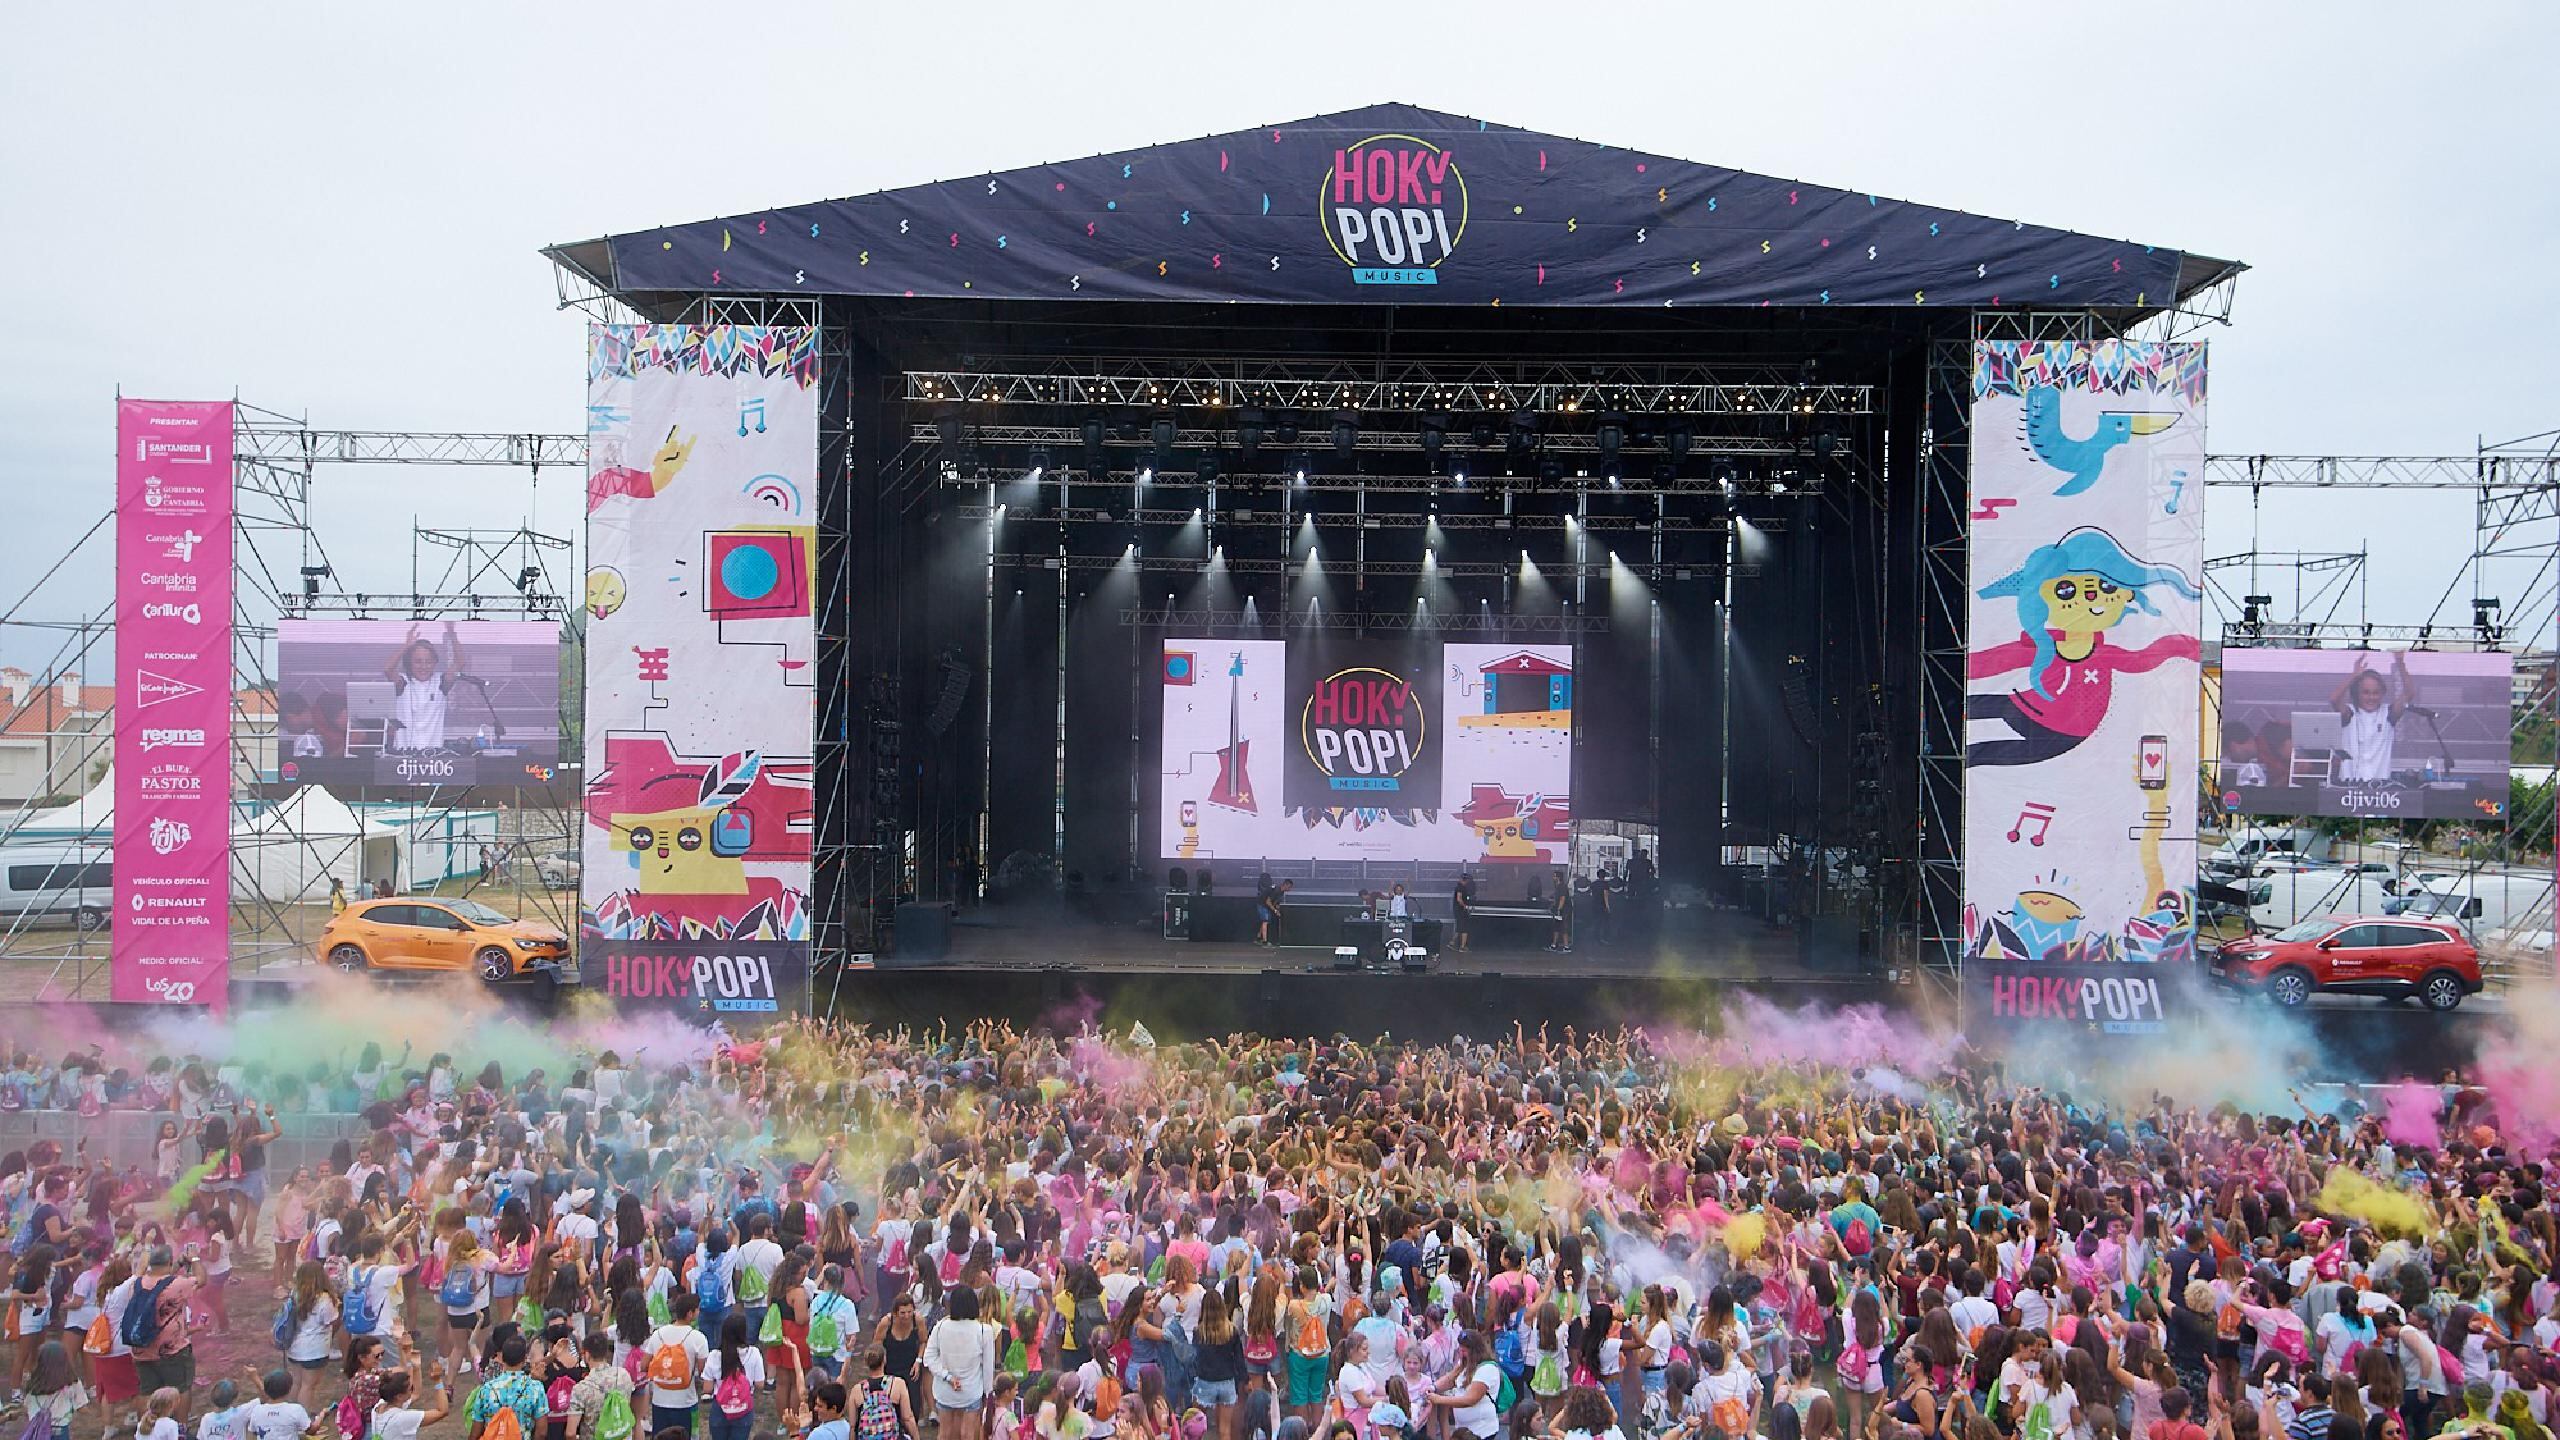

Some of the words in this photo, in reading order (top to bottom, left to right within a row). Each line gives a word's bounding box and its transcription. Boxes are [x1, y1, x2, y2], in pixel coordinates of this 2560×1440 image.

[1335, 149, 1452, 205] HOKY
[1335, 208, 1452, 265] POPI
[1365, 272, 1425, 281] MUSIC
[149, 443, 201, 453] SANTANDER
[146, 534, 184, 543] Cantabria
[141, 572, 197, 585] Cantabria
[1315, 680, 1411, 726] HOKY
[142, 729, 205, 745] regma
[1315, 728, 1411, 774] POPI
[396, 759, 454, 781] djivi06
[141, 777, 201, 789] PASTOR
[1339, 780, 1390, 788] MUSIC
[2341, 790, 2400, 813] djivi06
[147, 898, 207, 907] RENAULT
[132, 917, 156, 925] VIDAL
[158, 917, 171, 925] DE
[172, 917, 184, 925] LA
[185, 915, 210, 925] PEÑA
[722, 1001, 771, 1010] MUSIC
